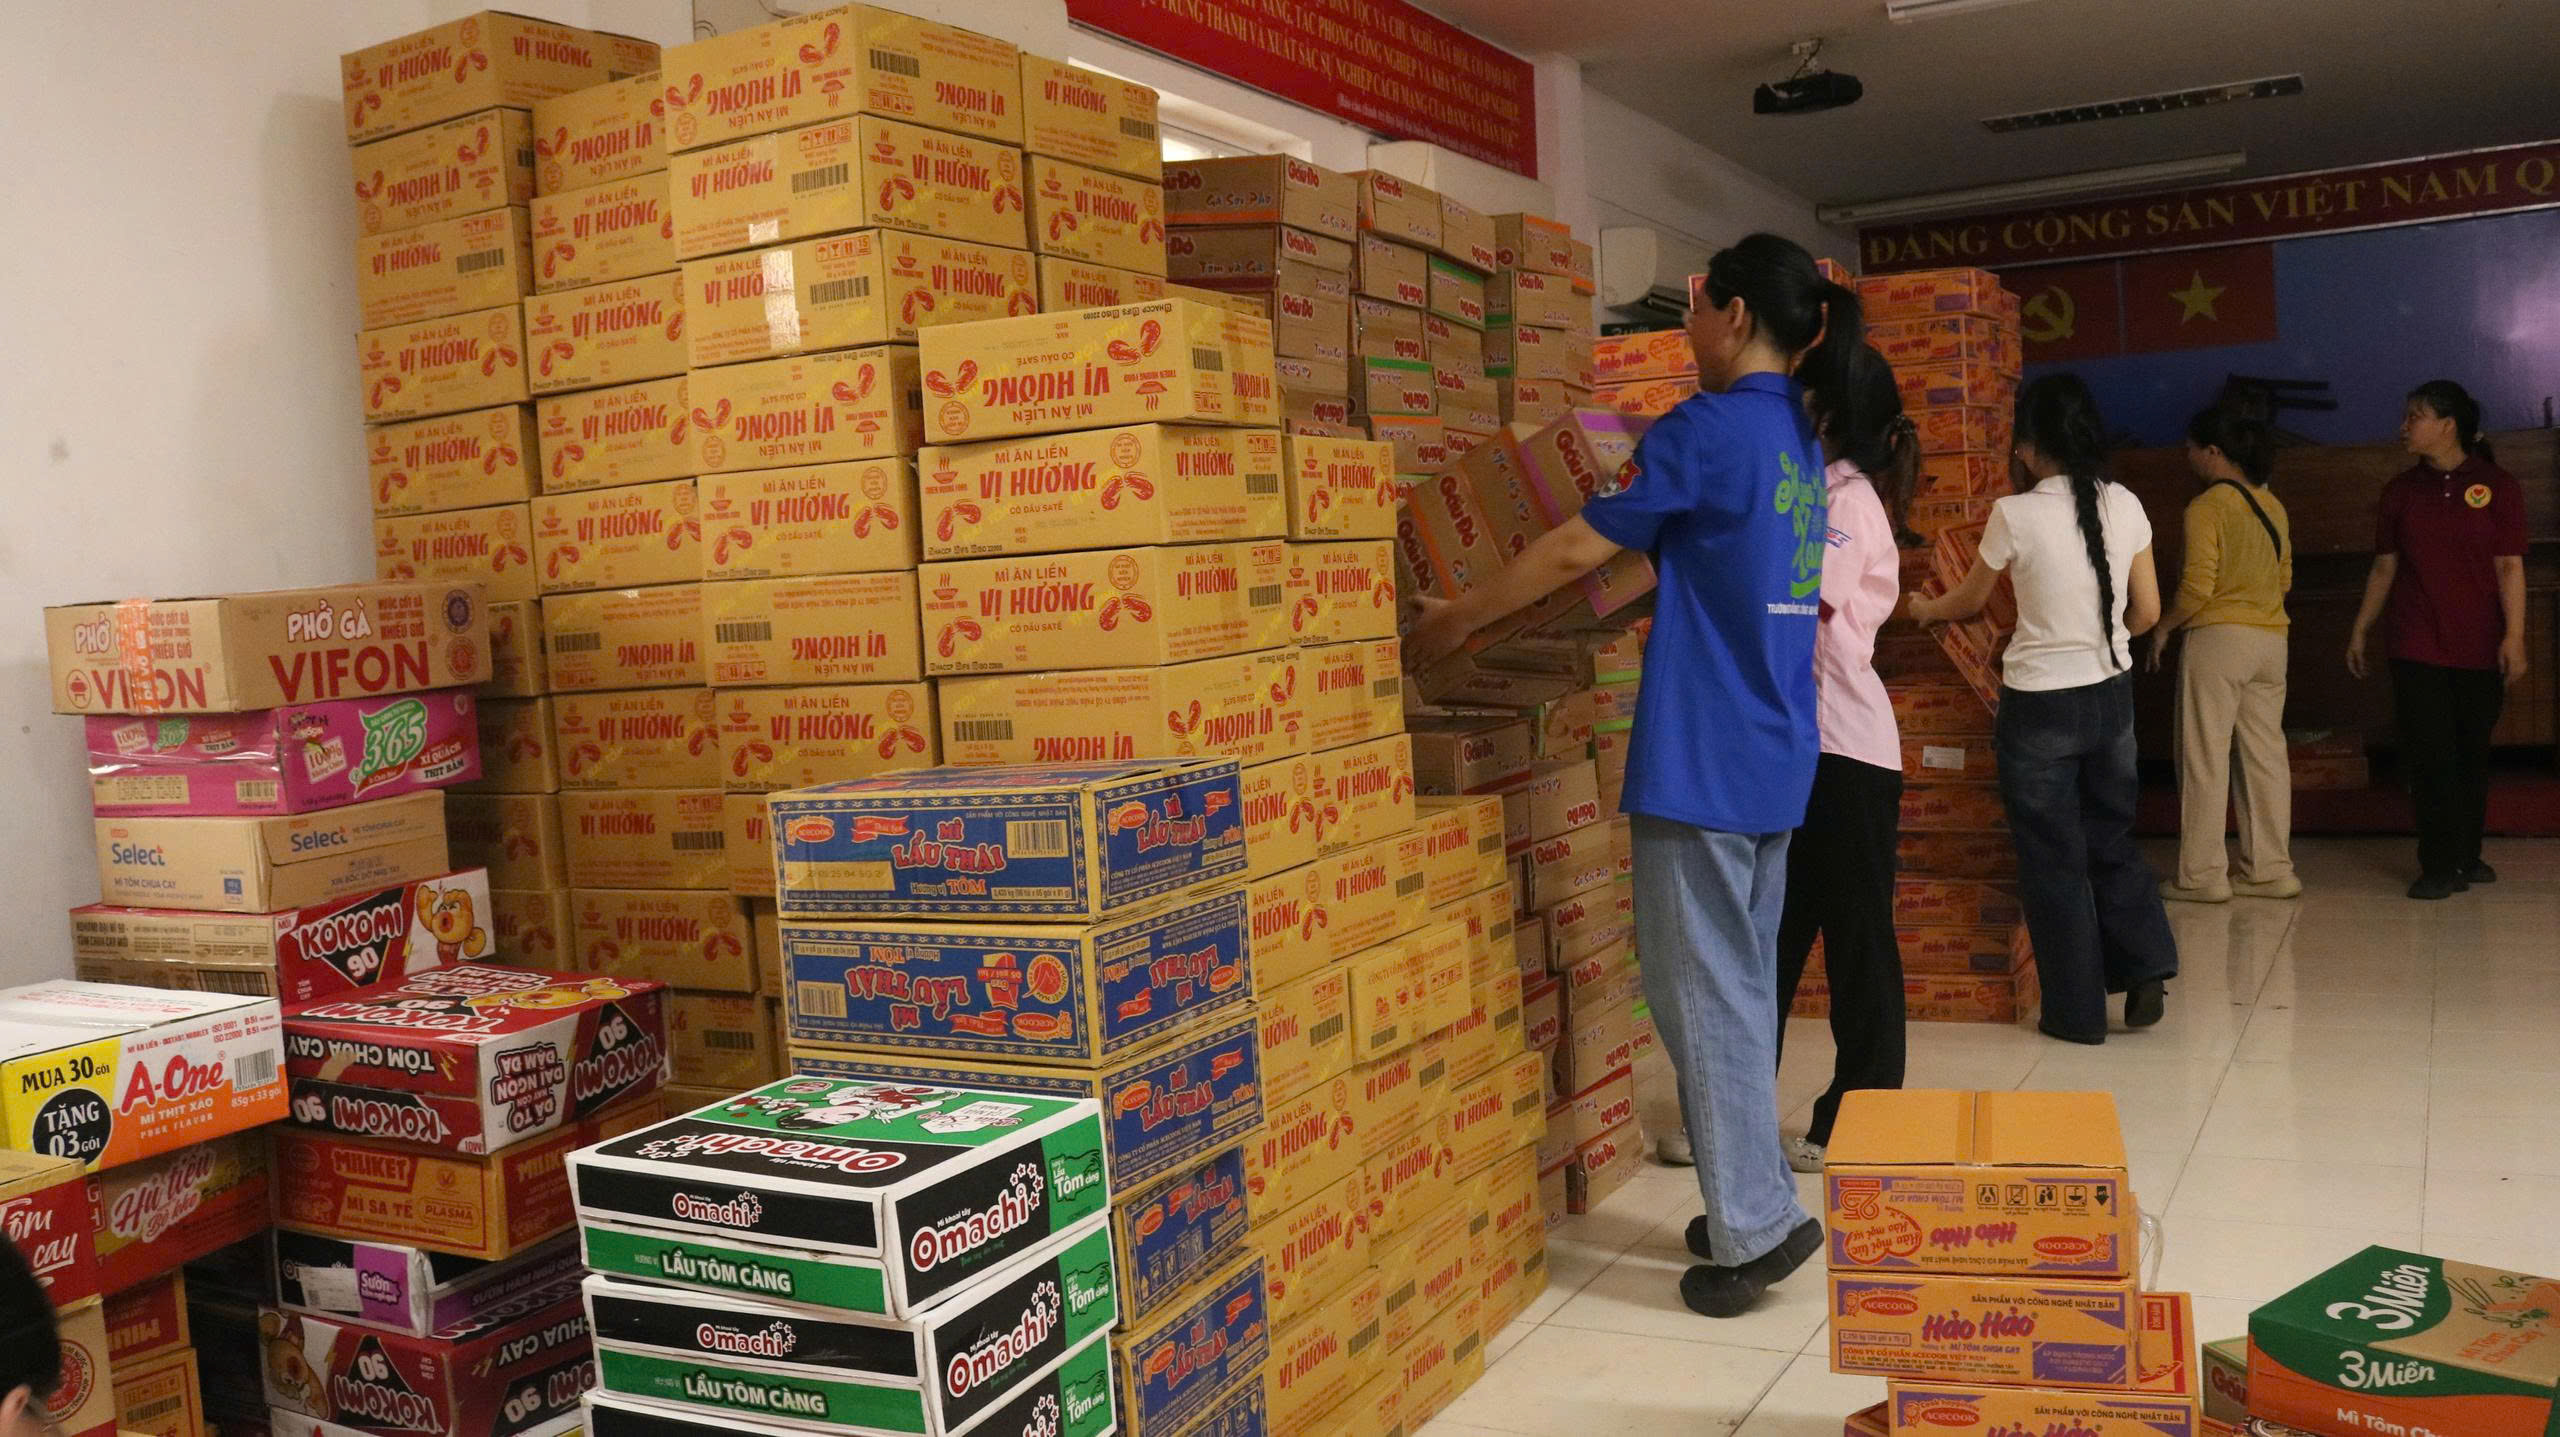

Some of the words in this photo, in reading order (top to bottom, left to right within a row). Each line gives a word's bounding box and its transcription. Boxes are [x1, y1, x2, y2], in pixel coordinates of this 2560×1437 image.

[692, 173, 707, 200] VỊ
[713, 160, 773, 193] HƯƠNG
[2250, 178, 2366, 222] VIỆT
[2381, 163, 2500, 208] NAM
[573, 214, 590, 242] VỊ
[596, 199, 658, 234] HƯƠNG
[983, 370, 1074, 407] HƯƠNG
[1084, 362, 1110, 396] VỊ
[736, 409, 807, 442] HƯƠNG
[814, 402, 834, 433] VỊ
[1013, 409, 1046, 425] LIỀN
[1052, 405, 1072, 419] ĂN
[1077, 403, 1093, 419] MÌ
[995, 449, 1011, 465] MÌ
[1014, 447, 1033, 462] ĂN
[1037, 443, 1068, 461] LIỀN
[1177, 453, 1190, 481] VỊ
[1193, 449, 1234, 476] HƯƠNG
[763, 481, 775, 493] MÌ
[779, 479, 797, 491] ĂN
[800, 475, 825, 490] LIỀN
[980, 470, 1002, 504] VỊ
[1010, 462, 1096, 497] HƯƠNG
[751, 499, 769, 530] VỊ
[777, 493, 849, 524] HƯƠNG
[979, 589, 1001, 617] VỊ
[1010, 582, 1095, 614] HƯƠNG
[74, 611, 111, 654] PHỞ
[287, 599, 334, 642] PHỞ
[339, 596, 372, 640] GÀ
[792, 635, 860, 662] HƯƠNG
[868, 630, 887, 658] VỊ
[91, 668, 207, 709] VION
[268, 640, 430, 704] VIFON
[363, 712, 423, 775] 365
[291, 826, 348, 852] Select
[937, 818, 964, 842] MÌ
[112, 843, 165, 866] Select
[891, 830, 943, 869] LẨU
[943, 842, 1006, 873] THÁI
[947, 876, 986, 895] TÔM
[299, 903, 404, 960] KOKOMI
[347, 947, 379, 977] 90
[844, 964, 911, 1001] THÁI
[913, 976, 971, 1020] LẨU
[290, 1034, 324, 1058] CAY
[600, 1016, 628, 1049] 90
[21, 1066, 66, 1093] MUA
[68, 1056, 94, 1082] 30
[96, 1064, 110, 1075] GÓI
[387, 1049, 435, 1075] TÔM
[575, 1034, 659, 1101] KOKOMI
[120, 1054, 224, 1116] A-One
[44, 1100, 100, 1135] TẶNG
[140, 1110, 155, 1125] MÌ
[158, 1104, 186, 1120] THỊT
[293, 1095, 326, 1123] 90
[332, 1096, 441, 1144] KOKOMI
[50, 1131, 80, 1158] 03
[81, 1136, 100, 1152] GÓI
[680, 1133, 907, 1174] Omachi
[1263, 1138, 1277, 1168] VỊ
[1280, 1111, 1326, 1158] HƯƠNG
[333, 1150, 411, 1185] MILIKET
[347, 1194, 364, 1211] MÌ
[369, 1199, 388, 1215] SA
[1055, 1176, 1084, 1198] Tôm
[424, 1205, 473, 1222] PLASMA
[673, 1192, 751, 1227] Omachi
[911, 1183, 1030, 1272] Omachi
[1930, 1225, 1972, 1252] Hảo
[1974, 1221, 2018, 1248] Hảo
[33, 1233, 78, 1269] cay
[662, 1248, 697, 1276] LẨU
[698, 1258, 737, 1283] TÔM
[741, 1263, 791, 1294] CÀNG
[1863, 1301, 1915, 1312] ACECOOK
[1922, 1310, 1977, 1342] Hảo
[1979, 1306, 2035, 1339] Hảo
[696, 1322, 783, 1357] Omachi
[948, 1302, 1048, 1398] Omachi
[358, 1353, 389, 1381] 90
[1279, 1367, 1293, 1390] VỊ
[1296, 1332, 1337, 1378] HƯƠNG
[2337, 1350, 2366, 1388] 3
[2363, 1360, 2435, 1389] Miền
[335, 1375, 439, 1433] KOKOMI
[684, 1372, 721, 1400] LẨU
[724, 1382, 767, 1407] TÔM
[769, 1388, 826, 1414] CÀNG
[2336, 1407, 2360, 1427] Mì
[2362, 1411, 2407, 1437] Tôm
